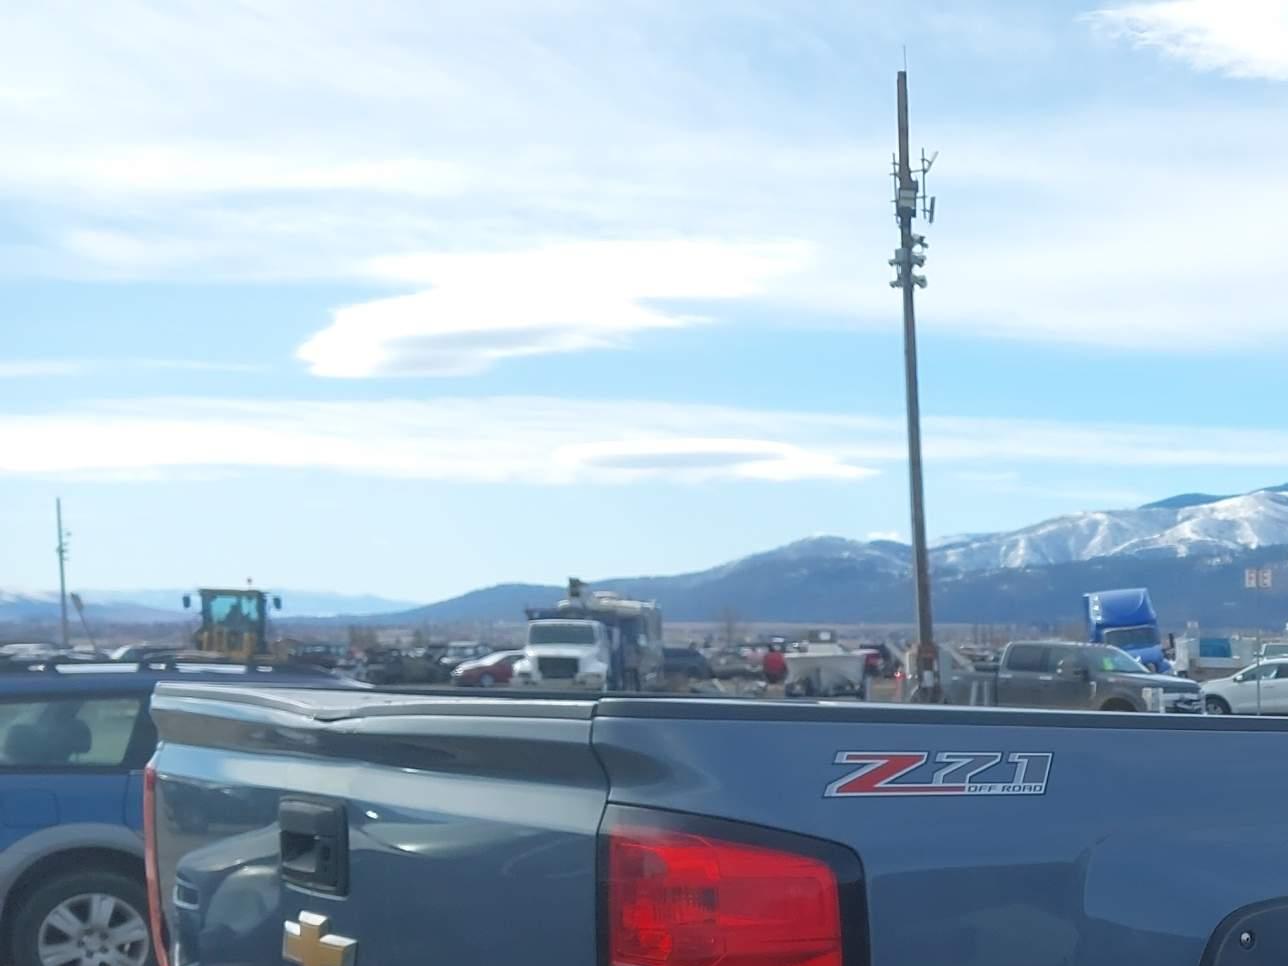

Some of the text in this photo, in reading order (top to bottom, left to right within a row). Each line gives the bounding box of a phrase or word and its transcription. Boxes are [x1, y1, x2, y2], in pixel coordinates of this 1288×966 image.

[823, 751, 1053, 797] Z71
[967, 784, 1043, 793] OFF ROAD
